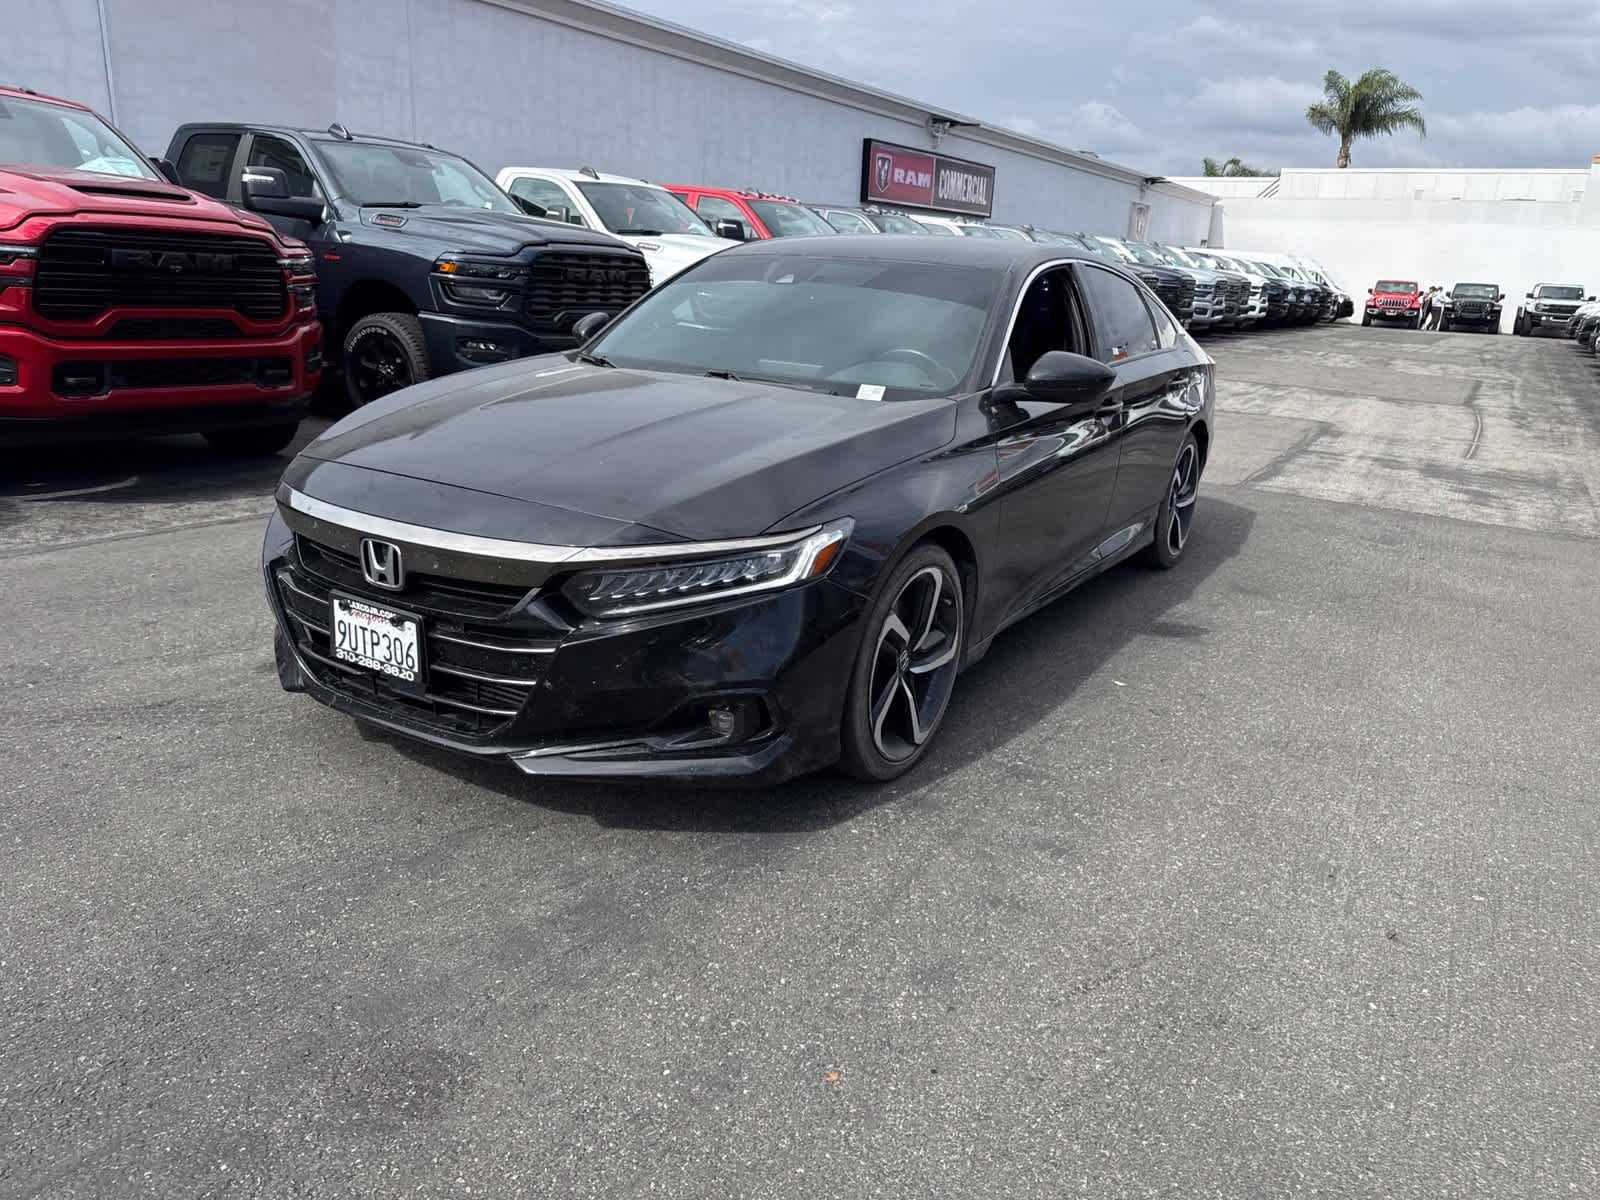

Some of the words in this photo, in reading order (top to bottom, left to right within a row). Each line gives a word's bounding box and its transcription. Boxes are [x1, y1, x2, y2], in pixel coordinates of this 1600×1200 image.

[893, 167, 932, 188] RAM
[938, 169, 988, 205] COMMERCIAL
[111, 248, 238, 271] RAM
[567, 267, 627, 283] RAM
[337, 619, 415, 670] 9UTP306
